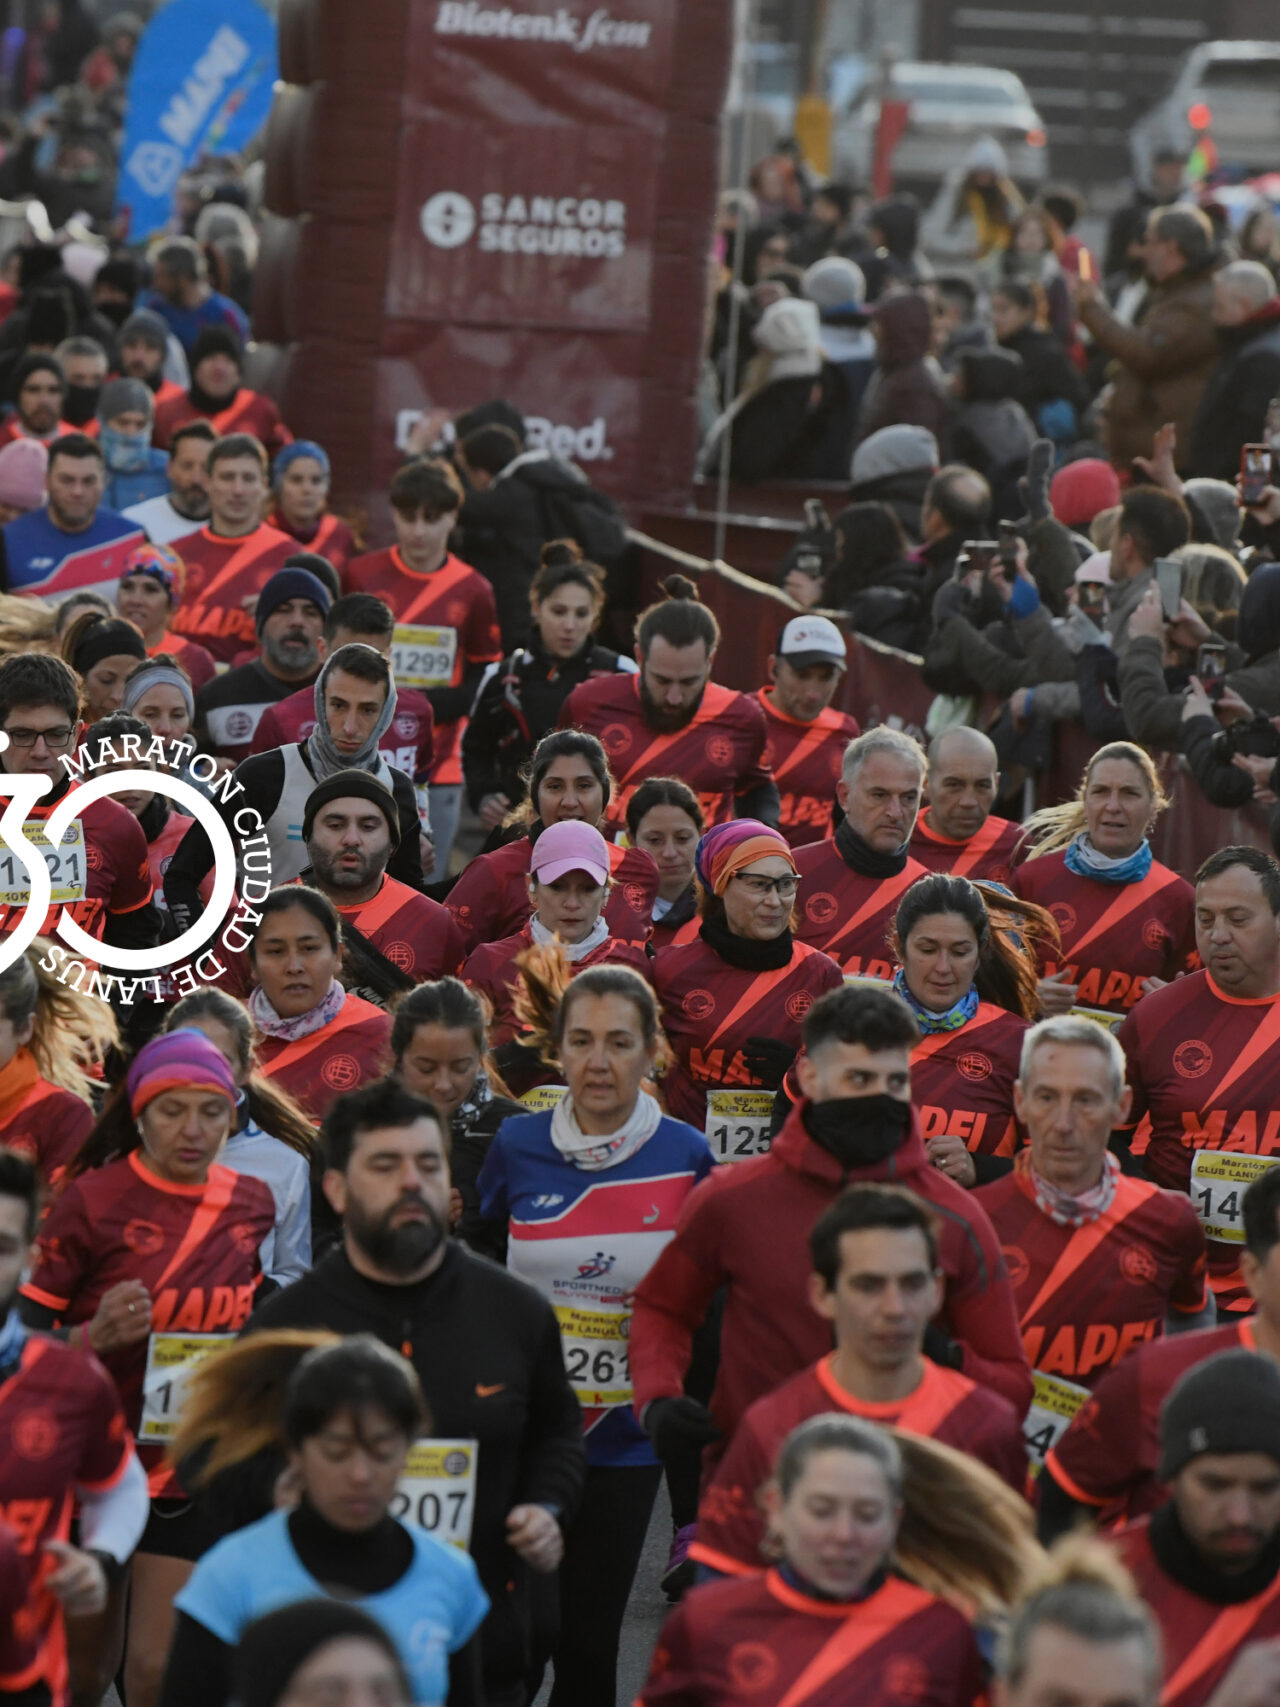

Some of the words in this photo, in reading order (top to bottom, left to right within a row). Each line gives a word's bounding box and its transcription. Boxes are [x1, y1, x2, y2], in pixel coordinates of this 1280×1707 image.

[480, 193, 627, 229] SANCOR
[478, 222, 627, 259] SEGUROS
[393, 650, 450, 674] 1299
[0, 852, 81, 886] 121
[1196, 1165, 1226, 1177] CLUB
